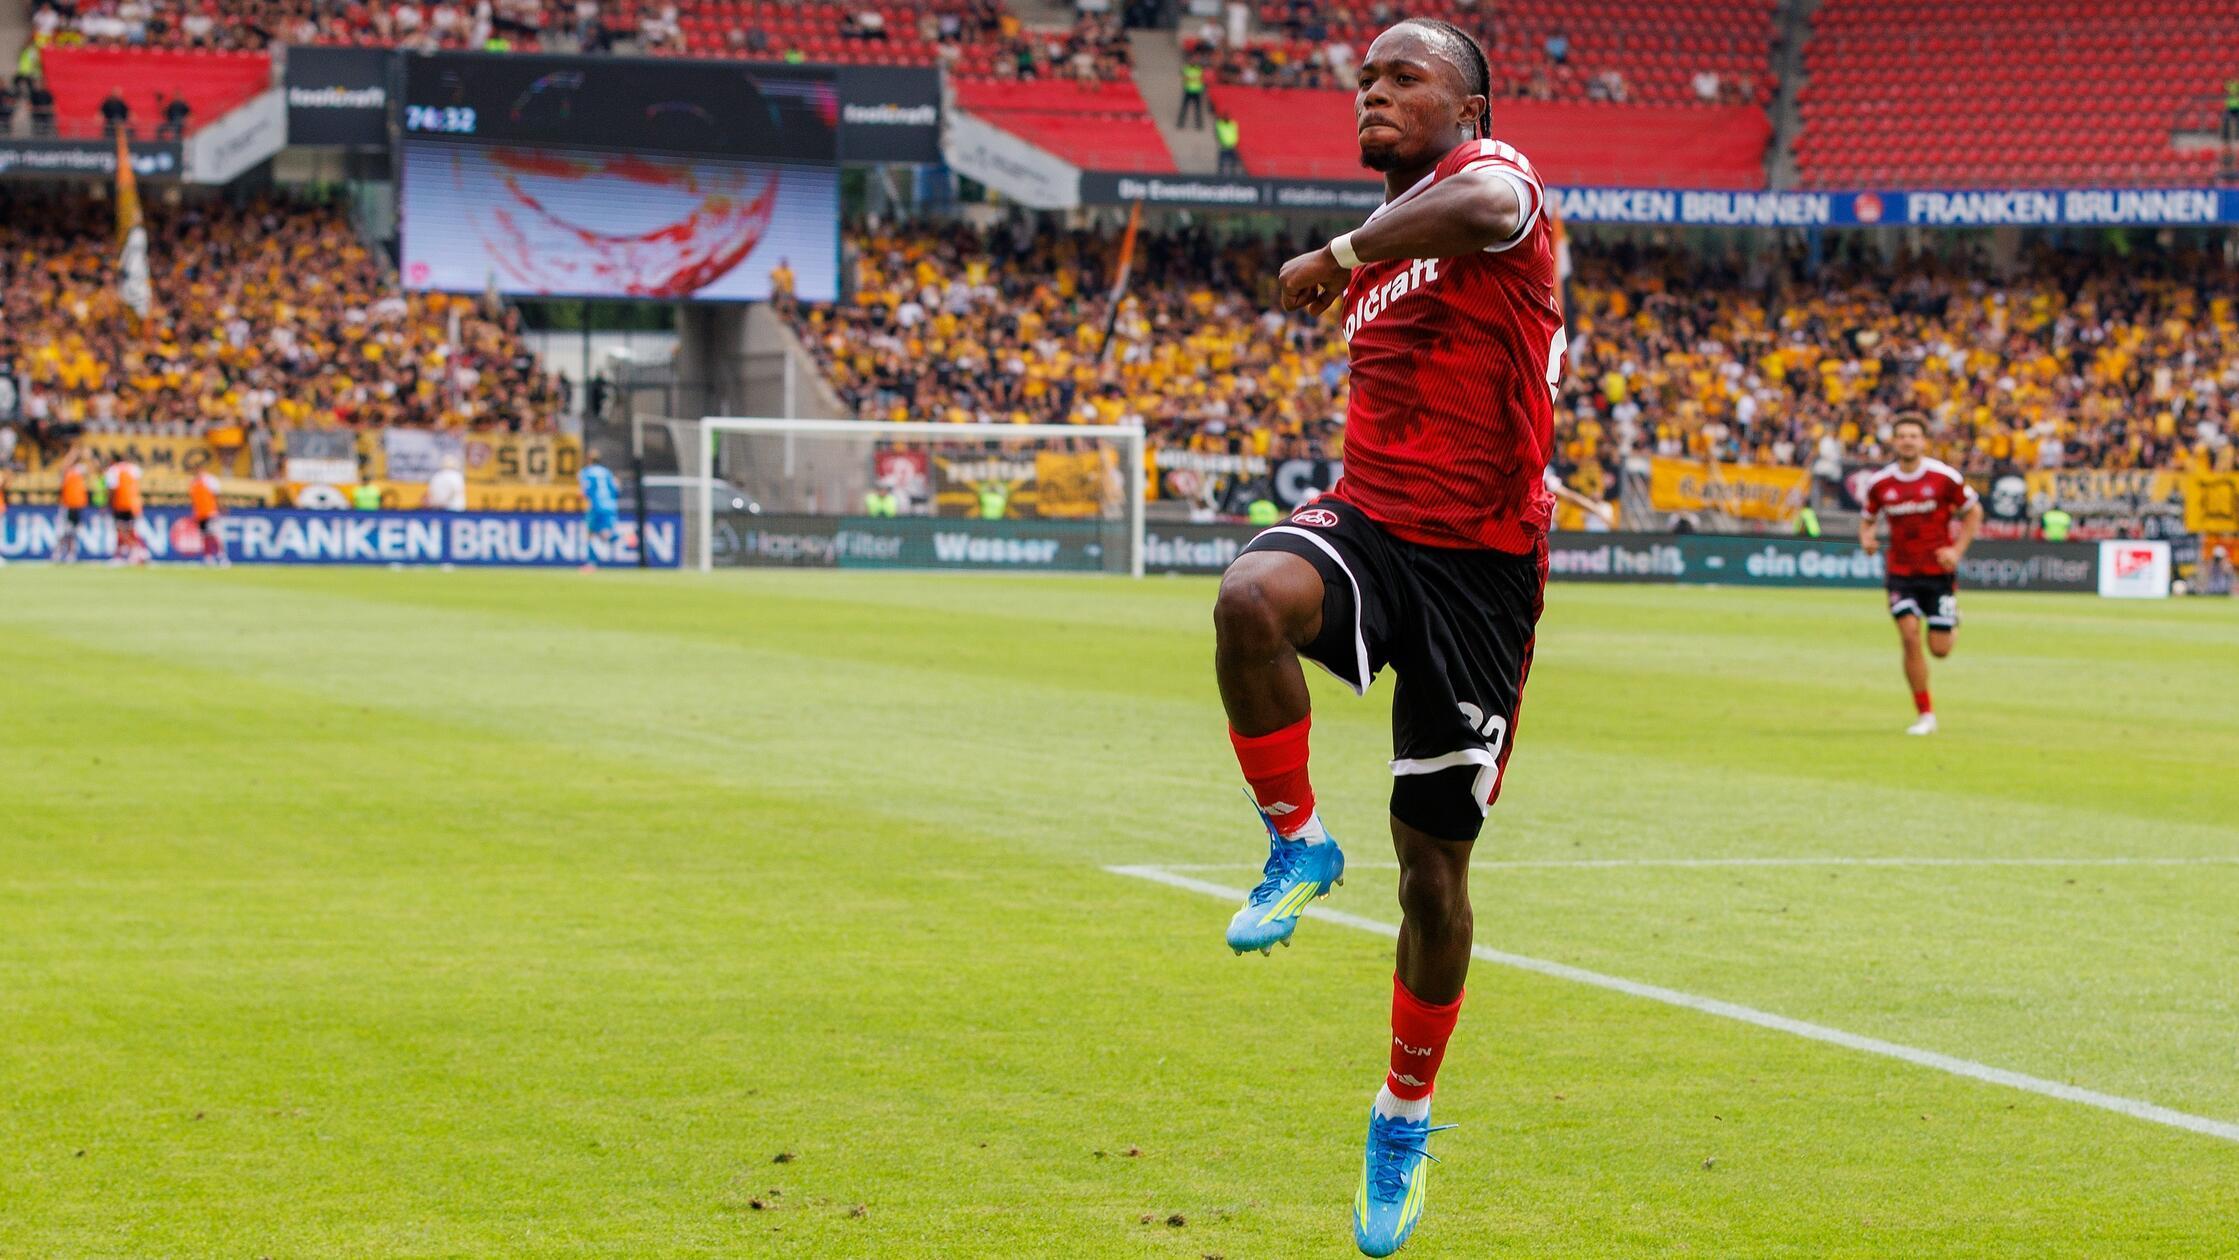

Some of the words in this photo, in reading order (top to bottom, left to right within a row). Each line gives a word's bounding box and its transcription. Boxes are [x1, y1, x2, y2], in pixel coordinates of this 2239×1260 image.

[1547, 187, 1676, 221] RANKEN
[1681, 190, 1830, 224] BRUNNEN
[1908, 190, 2057, 224] FRANKEN
[2064, 189, 2219, 223] BRUNNEN
[1343, 258, 1439, 343] olcraft
[0, 513, 168, 556] UNNN
[219, 515, 443, 560] FRANKEN
[450, 519, 675, 562] BRUNNEN
[933, 531, 1059, 562] Wasser
[1144, 533, 1239, 566] iskalt
[1550, 546, 1610, 574] end
[1746, 545, 1797, 577] ein
[1799, 547, 1885, 579] Gerät
[1960, 556, 2092, 587] appyFilter
